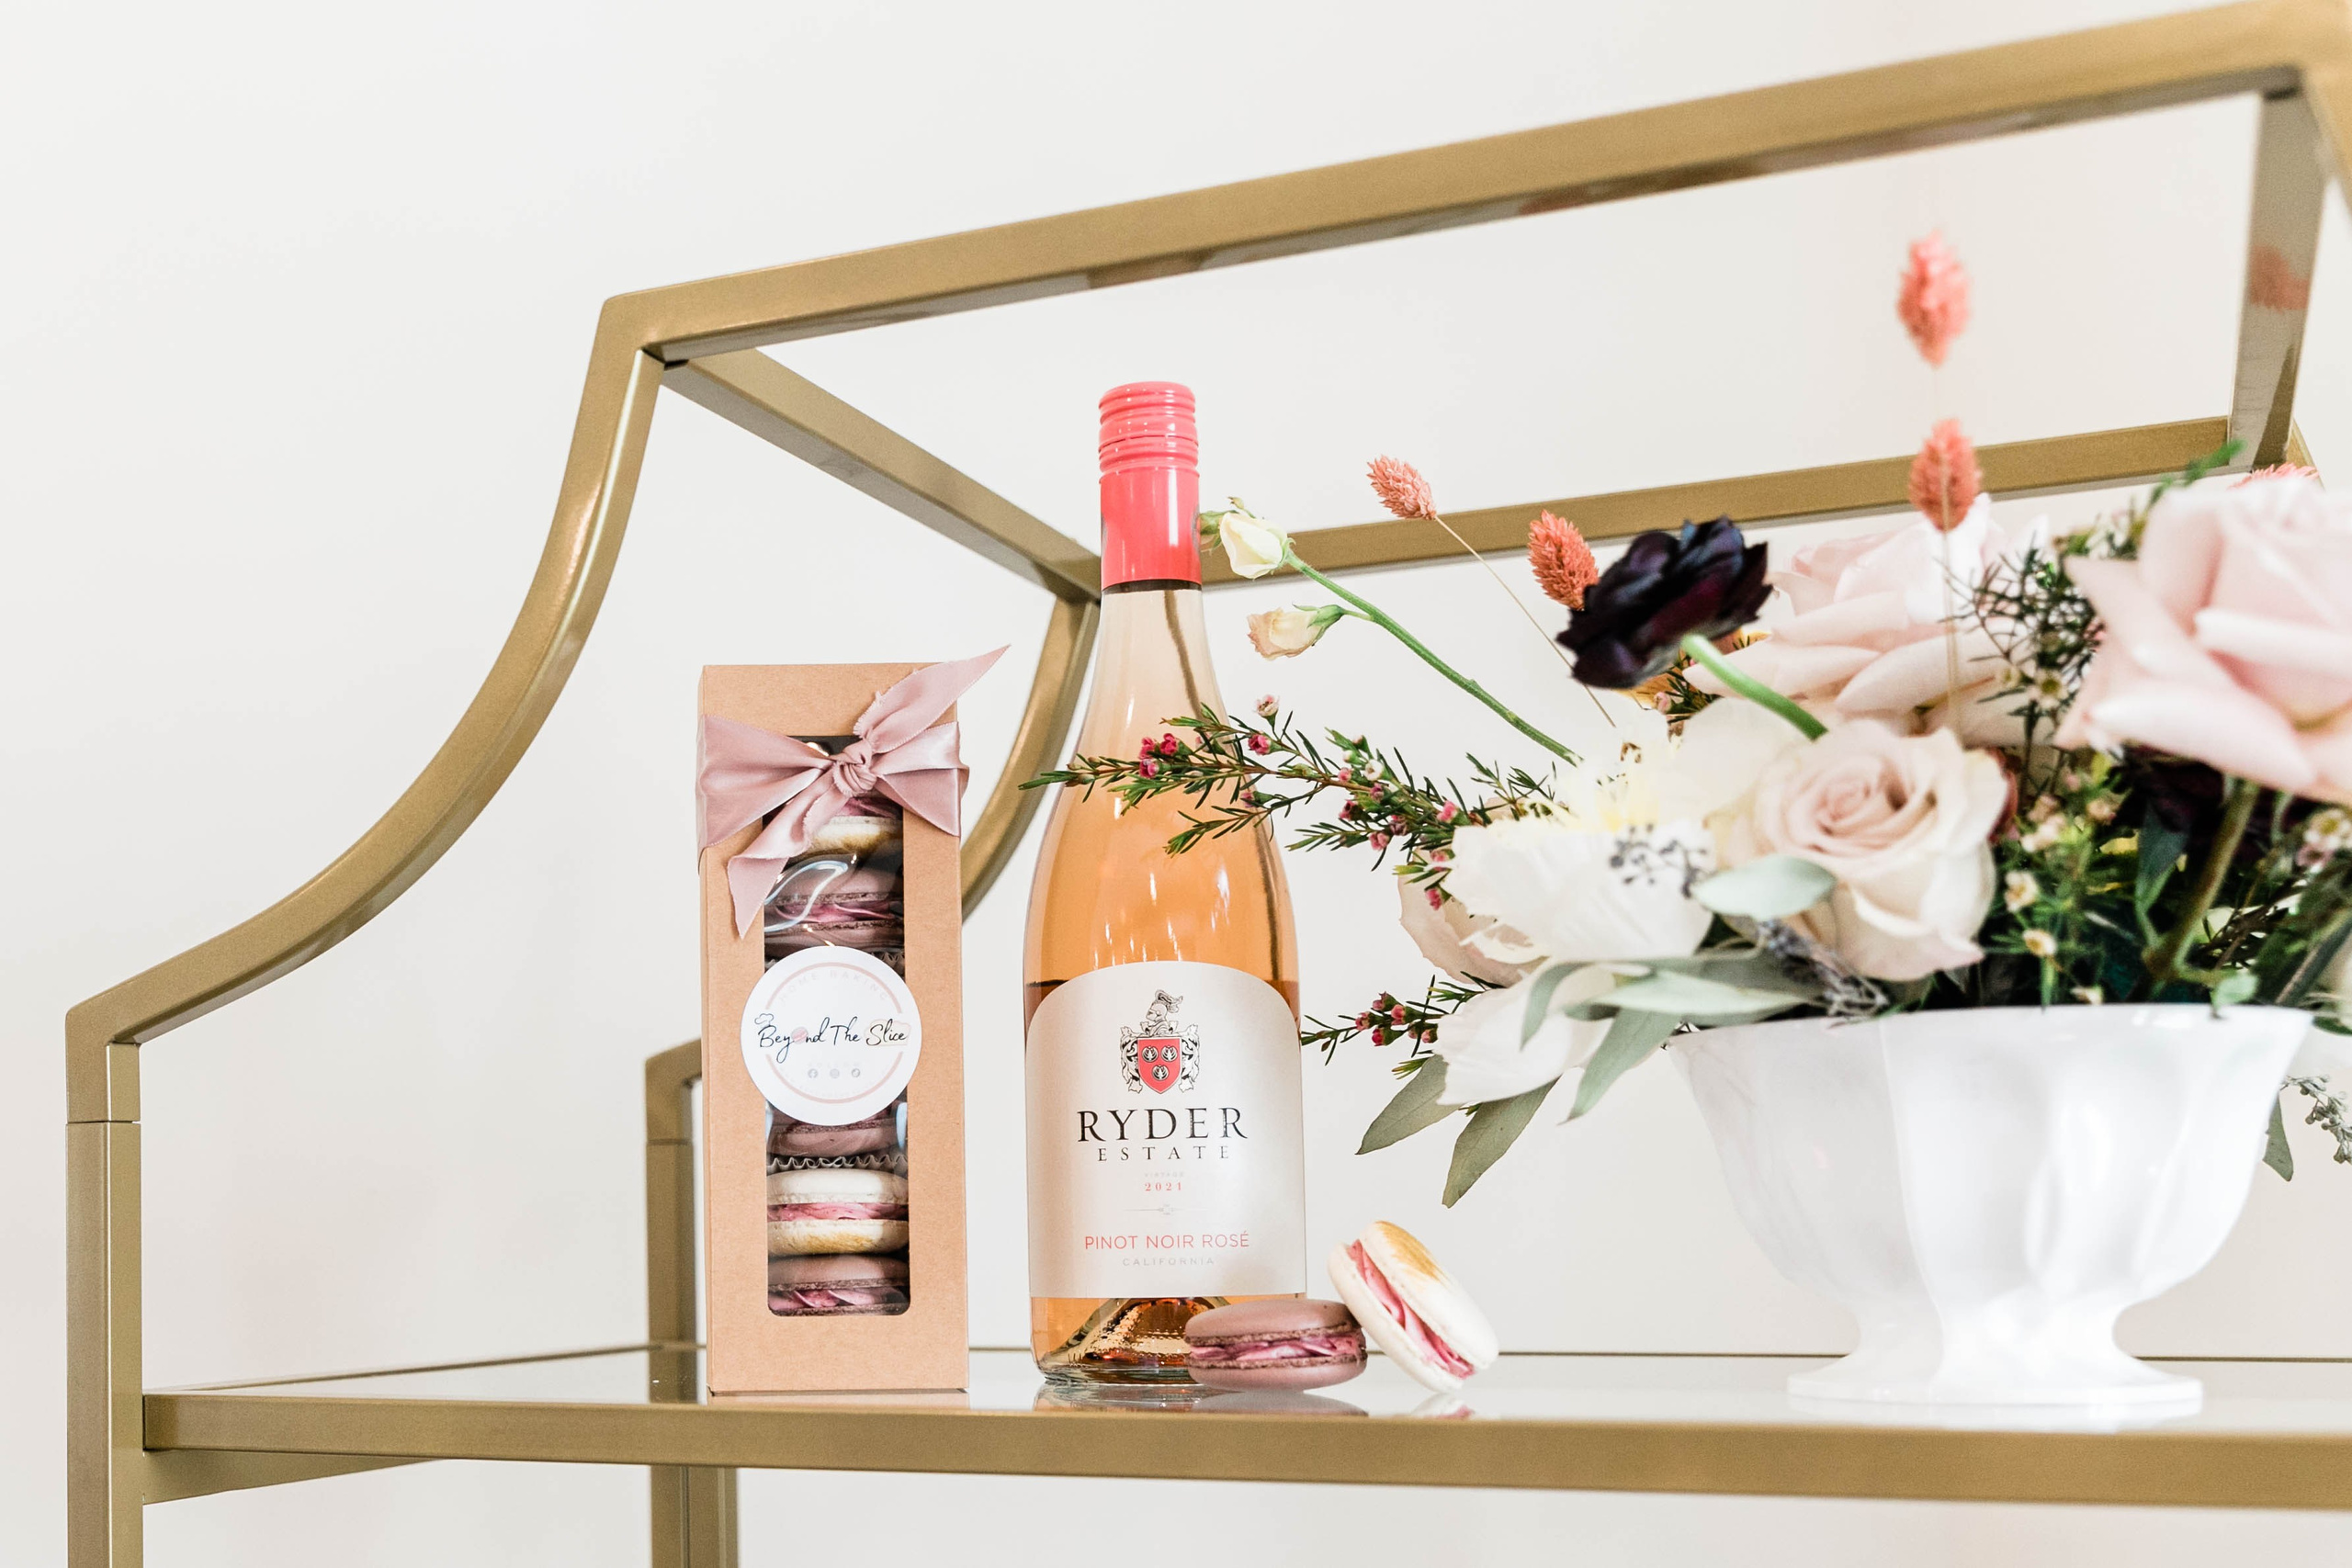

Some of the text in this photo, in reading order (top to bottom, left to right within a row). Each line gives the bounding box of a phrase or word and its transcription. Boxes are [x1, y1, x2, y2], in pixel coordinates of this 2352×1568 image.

[830, 1016, 861, 1047] The
[865, 1018, 907, 1047] Slice
[1077, 1107, 1249, 1142] RYDER
[1098, 1145, 1229, 1161] ESTATE
[1144, 1181, 1182, 1191] 2021
[1084, 1230, 1250, 1250] PINOT NOIR ROSÉ
[1122, 1257, 1215, 1267] CALIFORNIA
